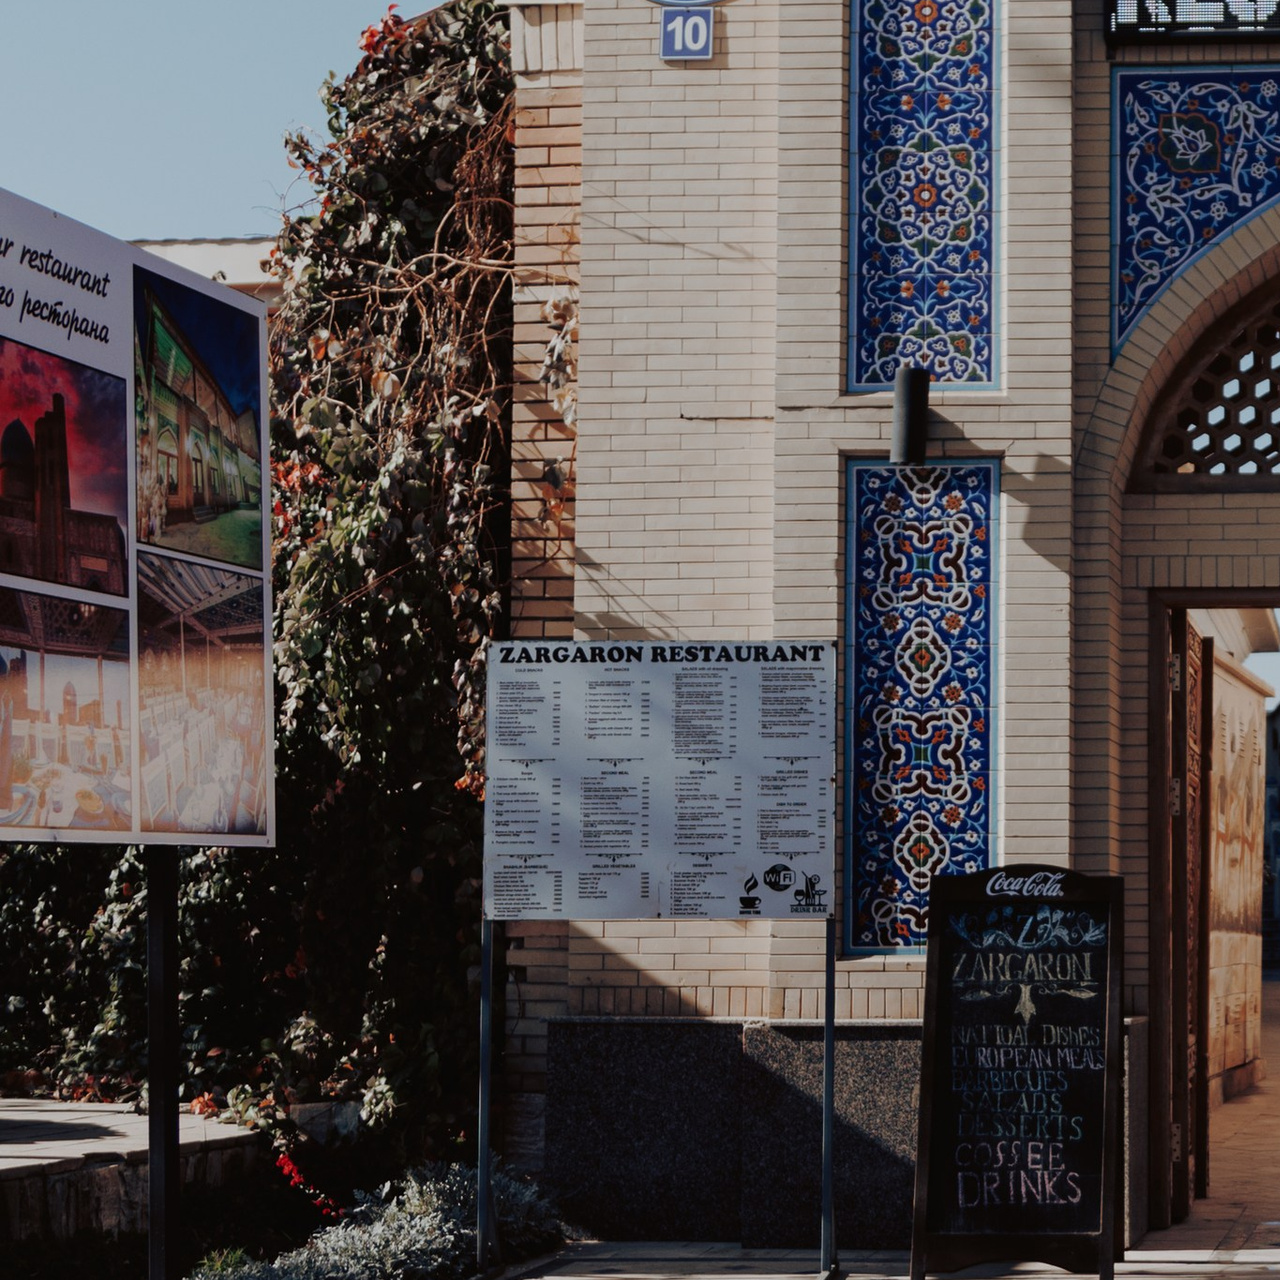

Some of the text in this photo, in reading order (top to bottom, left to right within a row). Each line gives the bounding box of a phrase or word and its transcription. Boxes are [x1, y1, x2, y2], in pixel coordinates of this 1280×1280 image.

[666, 15, 708, 51] 10
[19, 245, 111, 297] restaurant
[19, 289, 110, 344] ресторана
[500, 645, 825, 663] ZARGARON RESTAURANT
[986, 871, 1066, 897] Coca-Cola
[952, 952, 1093, 981] ZARGARON
[952, 1046, 1105, 1070] EUROPEAN MEALS
[952, 1070, 1069, 1092] BARBECUES
[961, 1091, 1063, 1114] SALADS
[957, 1114, 1084, 1141] DESSERTS
[957, 1170, 1083, 1209] DRINKS
